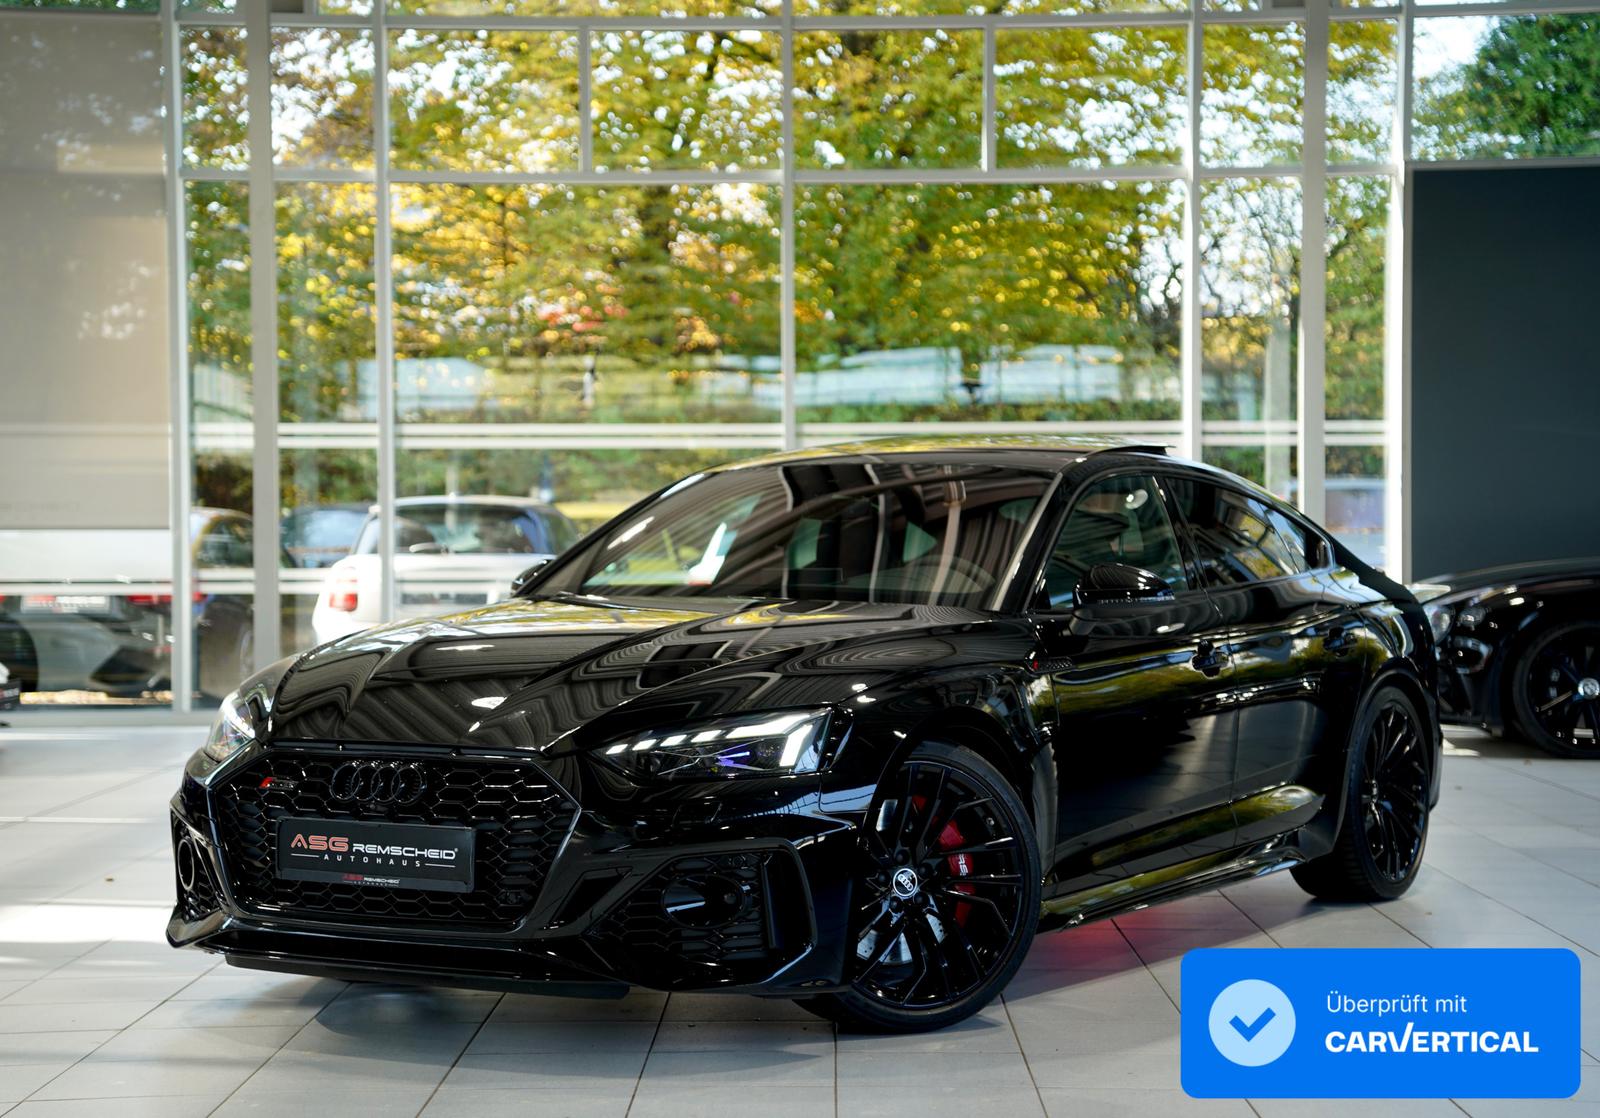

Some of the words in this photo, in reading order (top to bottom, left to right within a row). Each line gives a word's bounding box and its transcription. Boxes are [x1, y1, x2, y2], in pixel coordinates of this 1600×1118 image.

[290, 833, 349, 852] ASG
[353, 843, 457, 860] REMSCHEID
[324, 853, 421, 867] AUTOHAUS
